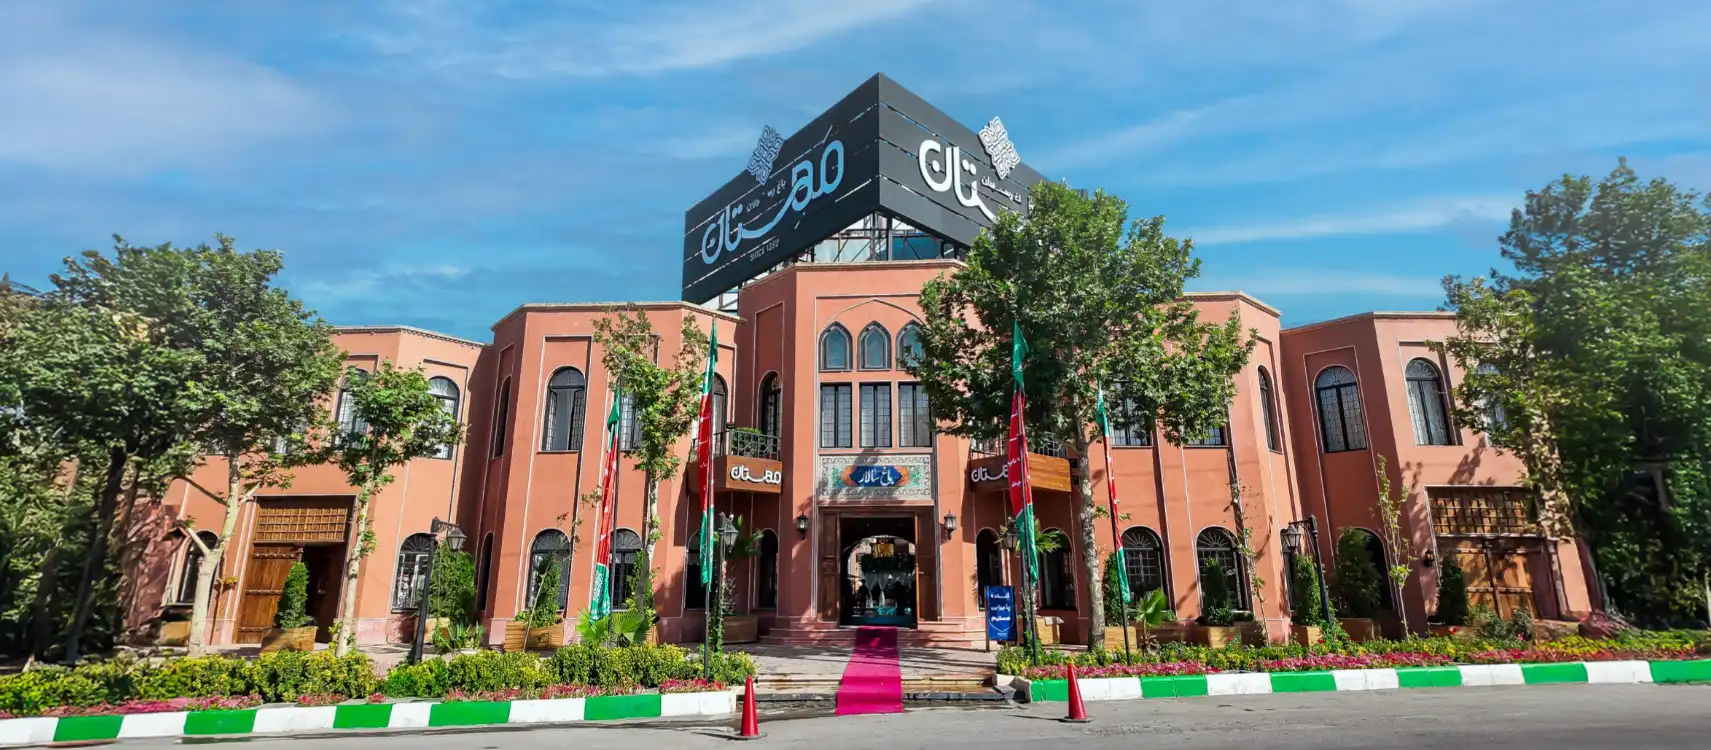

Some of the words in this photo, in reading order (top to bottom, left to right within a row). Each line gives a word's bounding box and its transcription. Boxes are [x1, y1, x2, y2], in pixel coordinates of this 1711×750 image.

[701, 139, 844, 265] مهستان
[749, 246, 765, 262] SINCE
[730, 464, 781, 485] مهستان
[858, 467, 880, 484] سالار
[880, 466, 894, 487] باغ
[971, 464, 1009, 483] هستان
